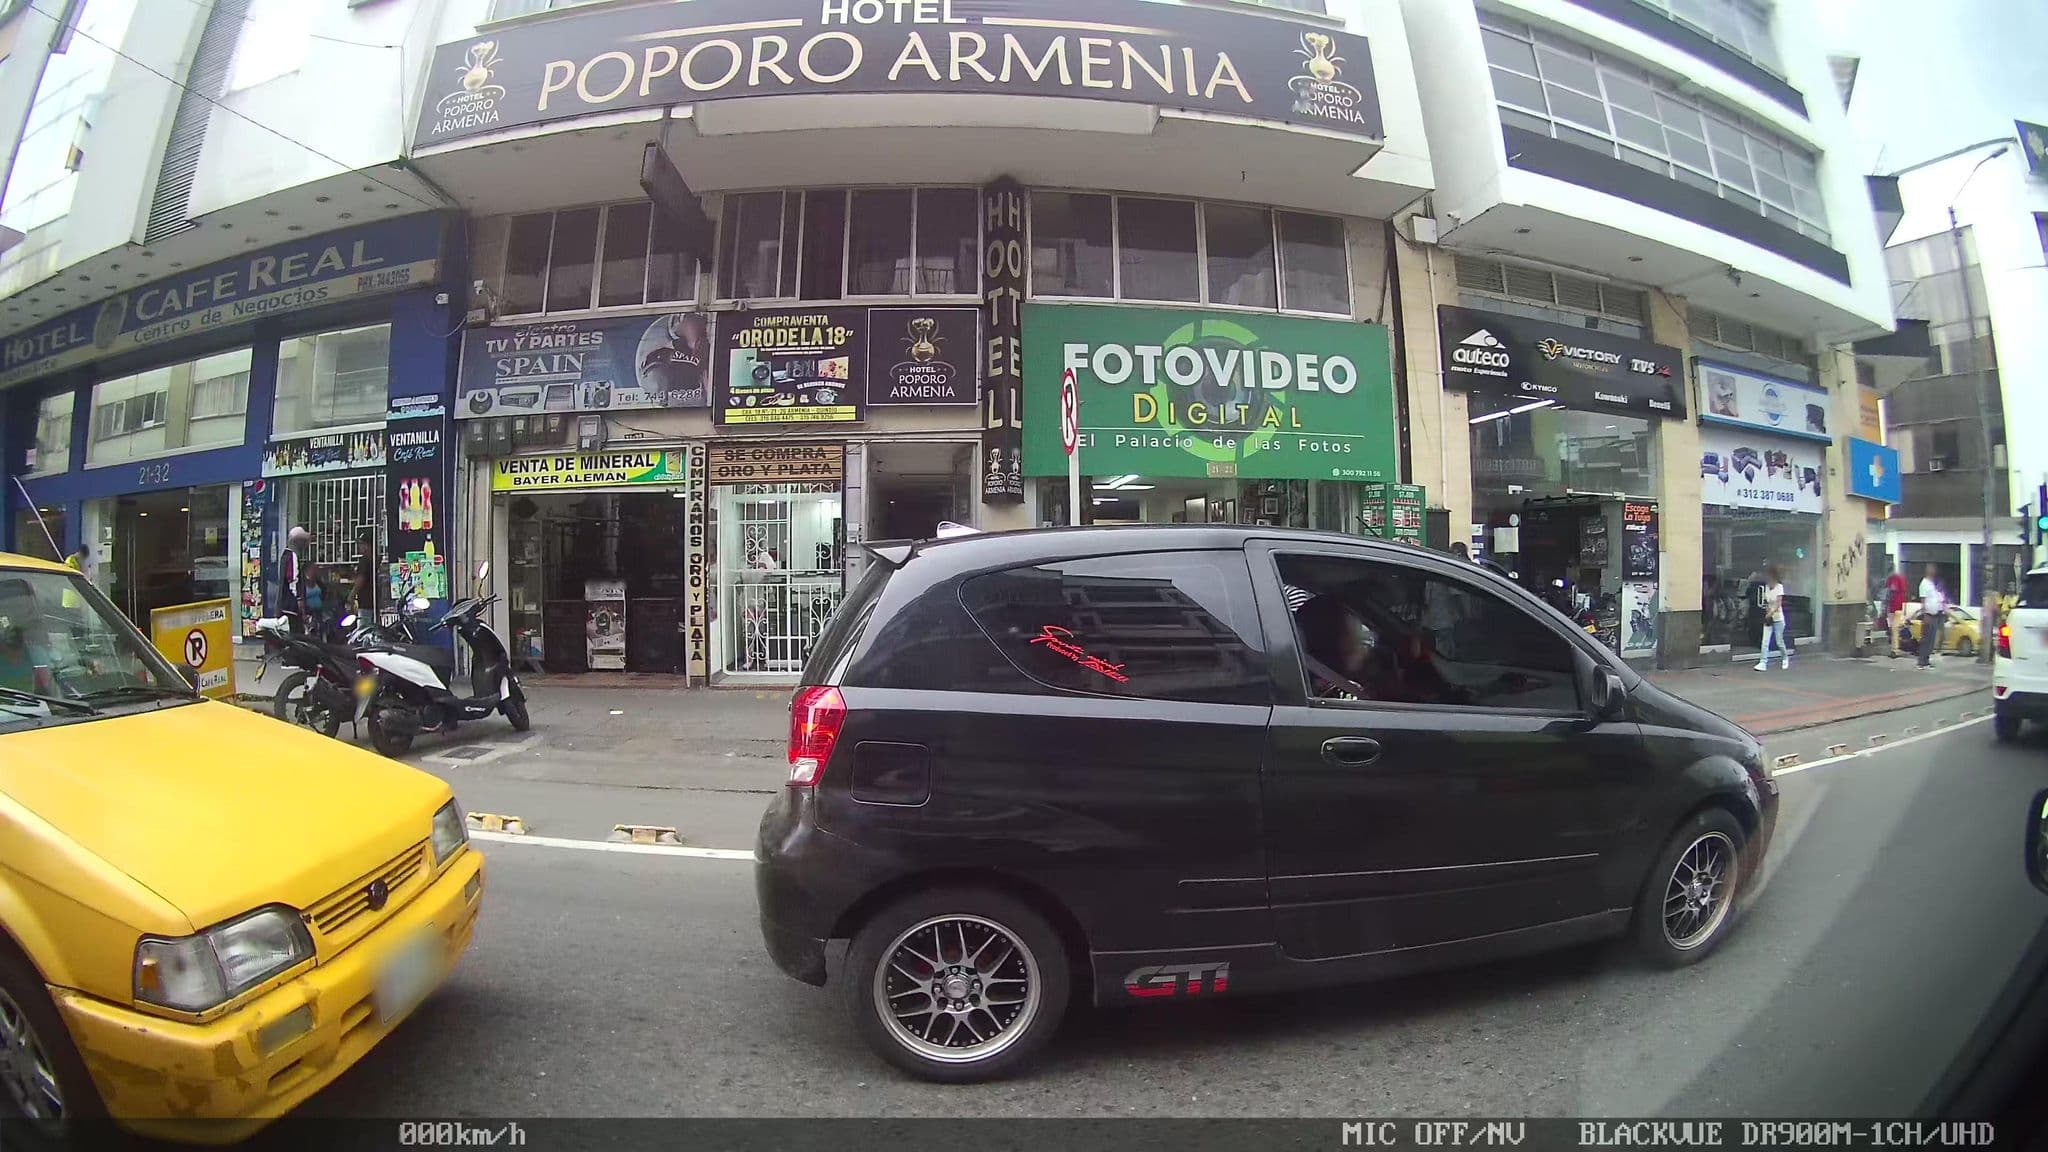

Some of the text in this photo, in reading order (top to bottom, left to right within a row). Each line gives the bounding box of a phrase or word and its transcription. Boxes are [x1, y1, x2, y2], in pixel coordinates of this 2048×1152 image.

[820, 0, 967, 25] HOTEL
[538, 30, 1253, 111] POPORO ARMENIA
[444, 98, 494, 118] POPORO
[457, 92, 485, 104] HOTEL
[431, 109, 500, 135] ARMENIA
[136, 239, 385, 321] CAFE REAL
[134, 285, 329, 344] Centro de Negocios
[753, 315, 829, 328] COMPRAVENTA
[4, 322, 87, 368] HOTEL
[486, 339, 508, 353] TV
[514, 338, 525, 351] Y
[529, 331, 604, 350] PARTES
[496, 352, 585, 378] SPAIN
[673, 350, 700, 365] SPAIN
[1453, 347, 1510, 368] auteco
[1563, 345, 1623, 364] VICTORY
[1064, 343, 1358, 395] FOTOVIDEO
[1631, 358, 1656, 374] TVS
[898, 374, 947, 384] POPORO
[618, 392, 639, 402] Tel:
[671, 388, 702, 400] 6288
[889, 385, 956, 398] ARMENIA
[1133, 392, 1302, 429] DIGITAL
[389, 430, 440, 447] VENTANILLA
[1077, 433, 1352, 454] El Palacio de las Fotos
[499, 452, 656, 475] VENTA DE MINERAL
[724, 447, 827, 461] SE COMPRA
[513, 472, 627, 486] BAYER ALEMAN
[718, 462, 833, 477] ORO Y PLATA
[689, 446, 705, 661] COMPRAMOS ORO Y PLATA
[1123, 961, 1231, 998] GTI
